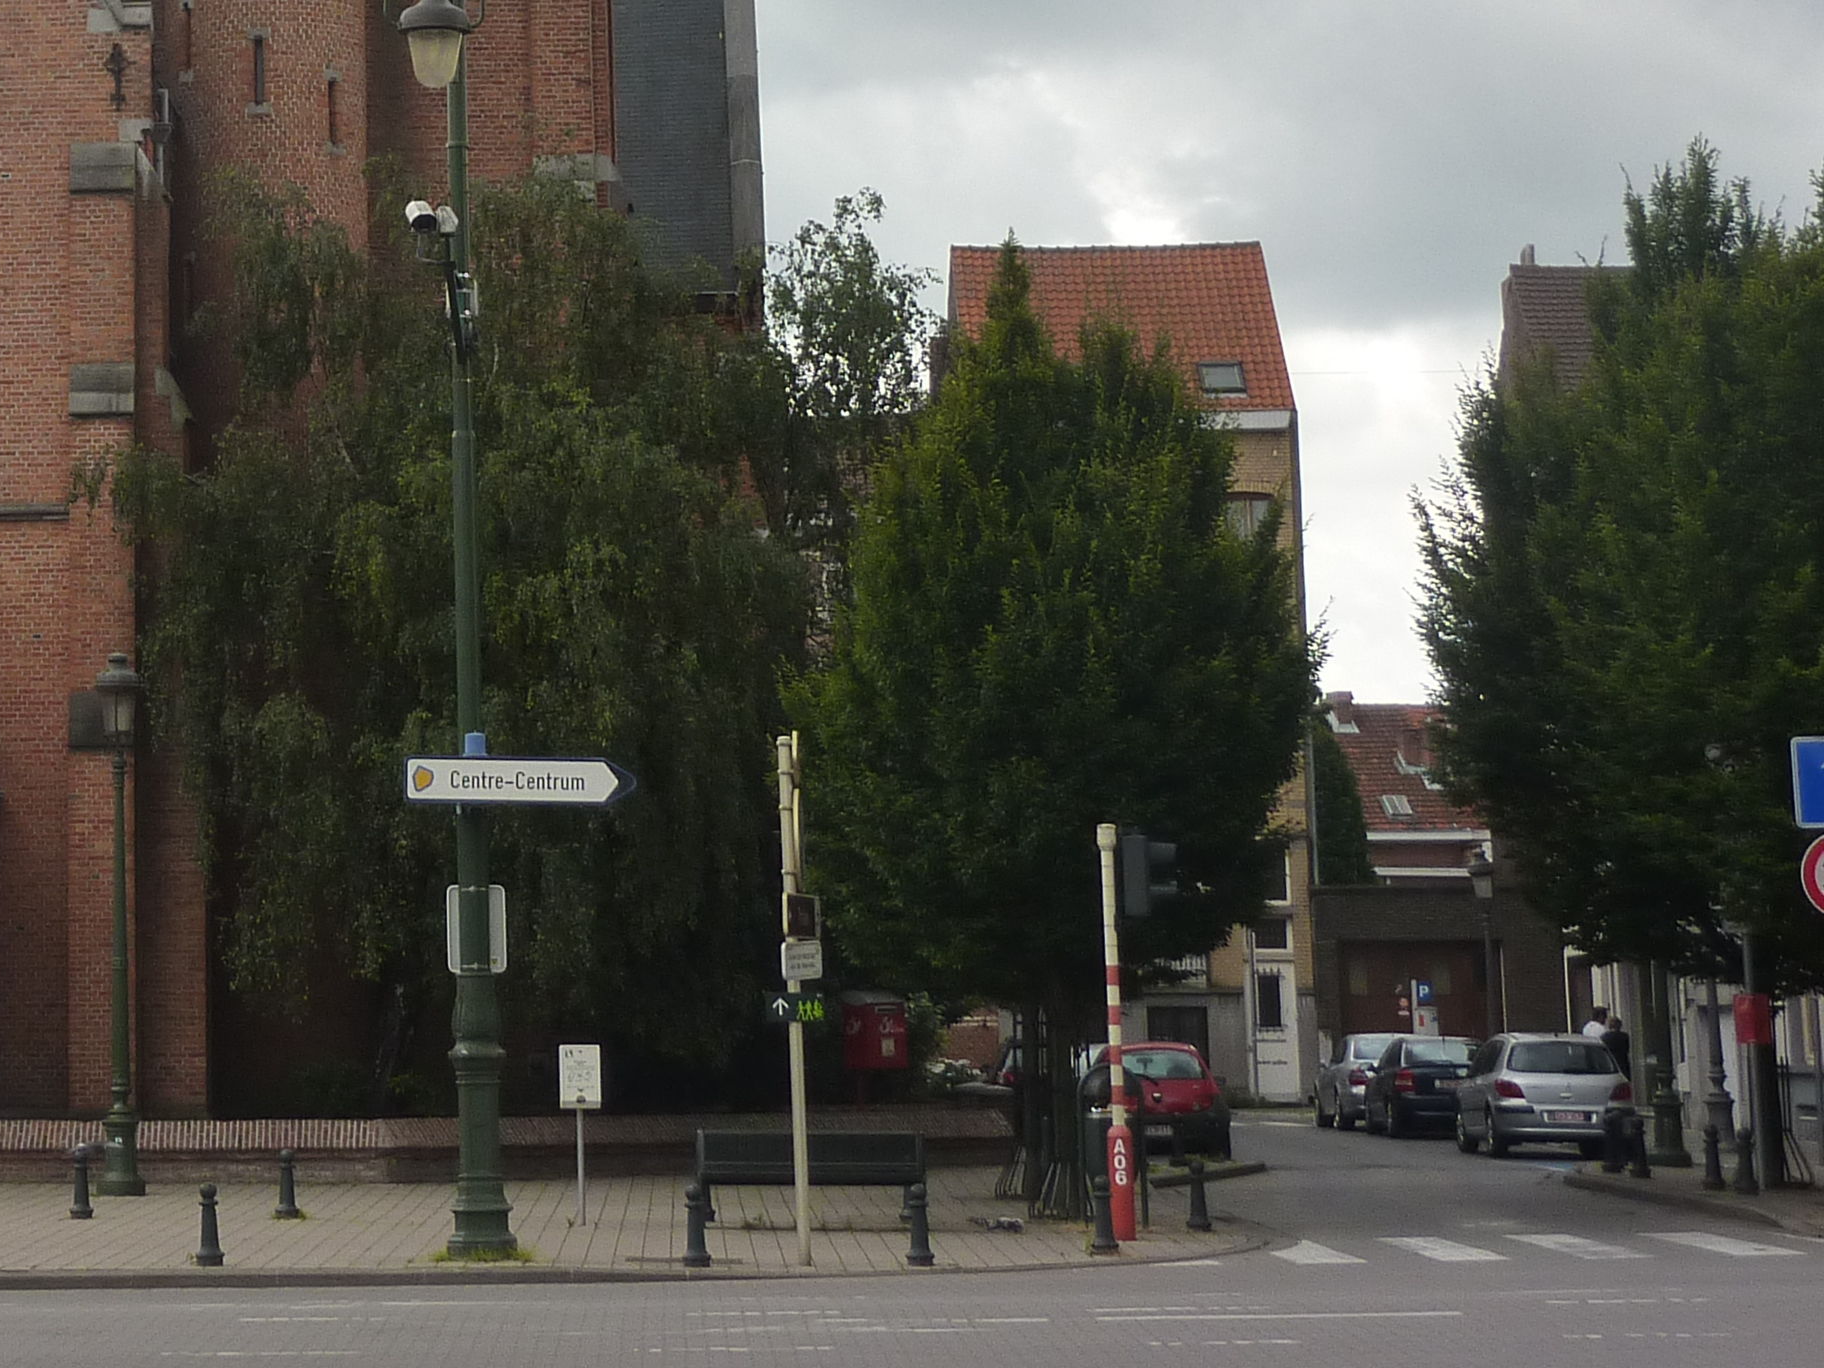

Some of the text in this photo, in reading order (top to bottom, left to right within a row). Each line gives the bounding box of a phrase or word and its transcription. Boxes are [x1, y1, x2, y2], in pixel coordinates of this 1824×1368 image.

[449, 769, 586, 792] Centre-Centrum
[1418, 985, 1430, 998] P
[1113, 1138, 1128, 1186] A06
